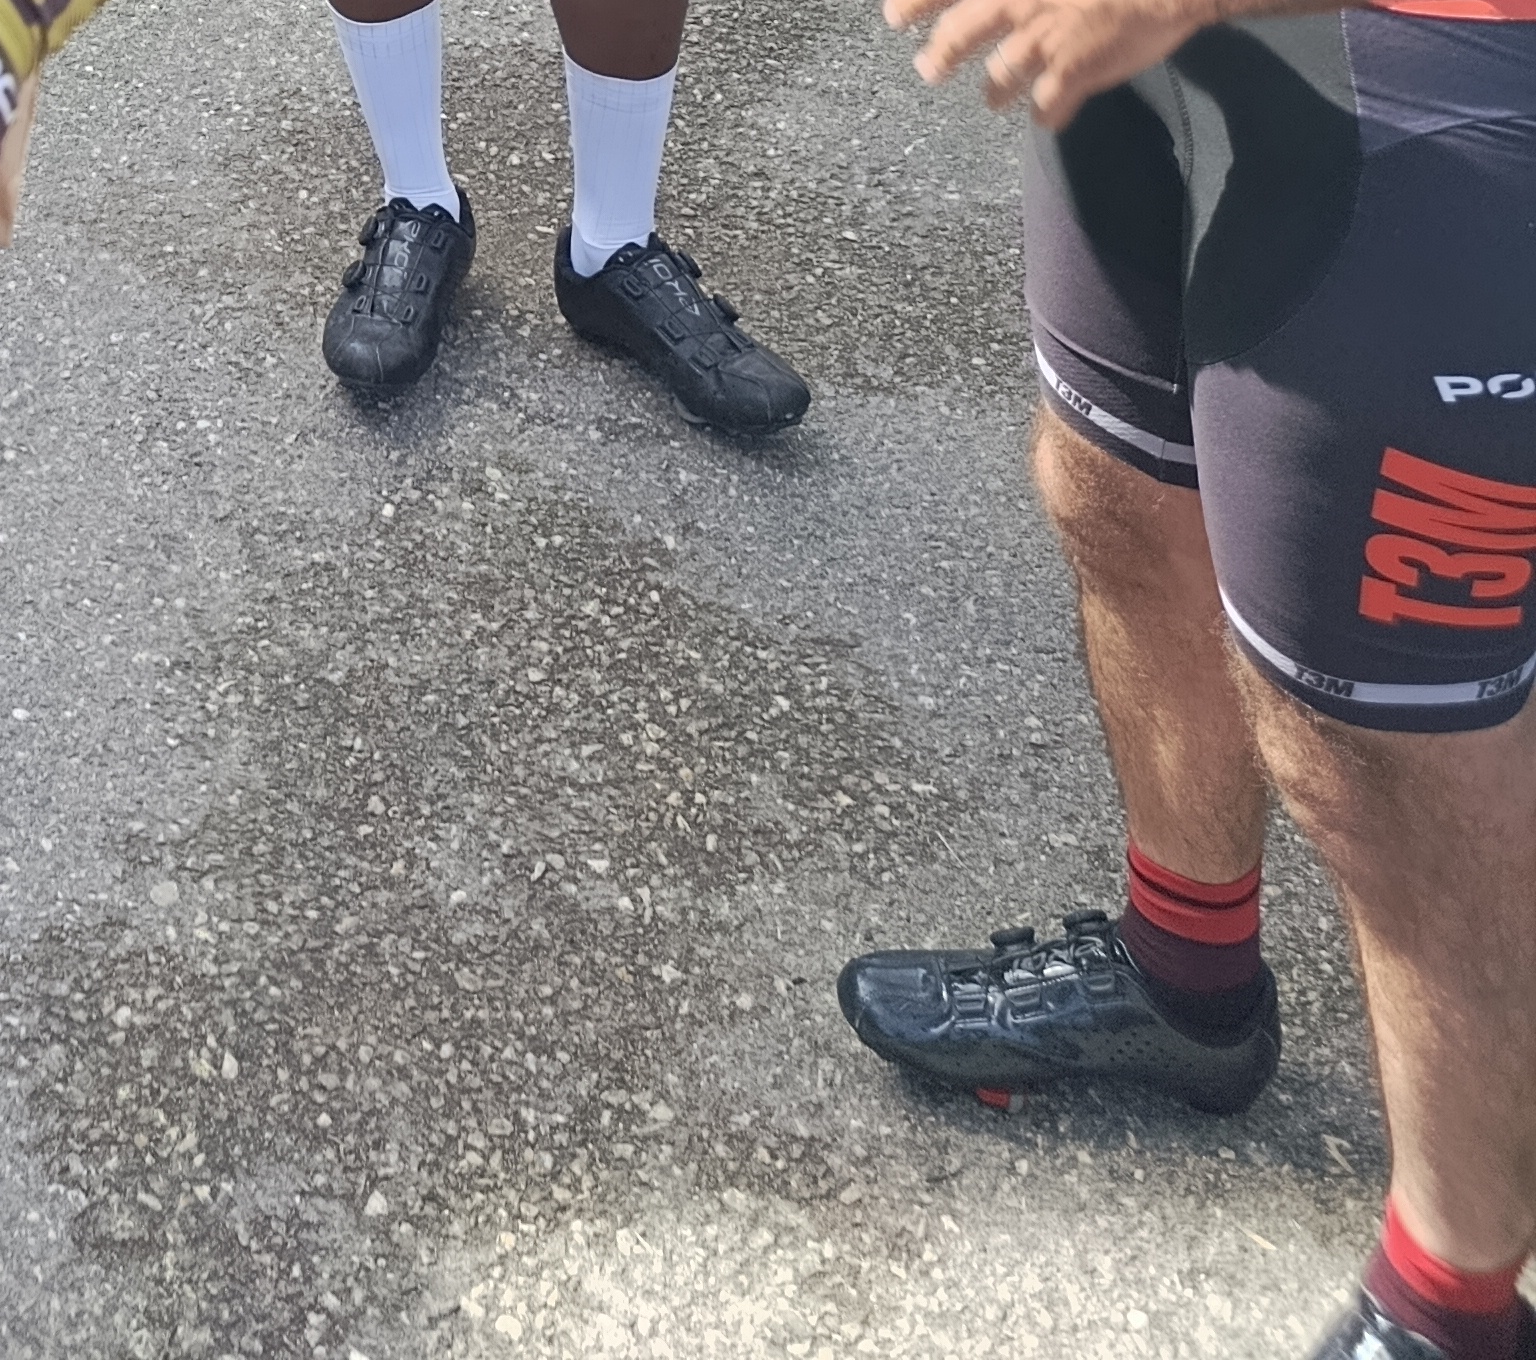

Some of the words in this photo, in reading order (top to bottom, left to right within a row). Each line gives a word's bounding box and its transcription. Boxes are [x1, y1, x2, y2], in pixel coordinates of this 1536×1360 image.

[1054, 380, 1094, 418] T3M
[1432, 373, 1535, 403] PO
[1358, 445, 1536, 631] T3M
[1293, 664, 1357, 699] T3M
[1476, 662, 1526, 699] T3M
